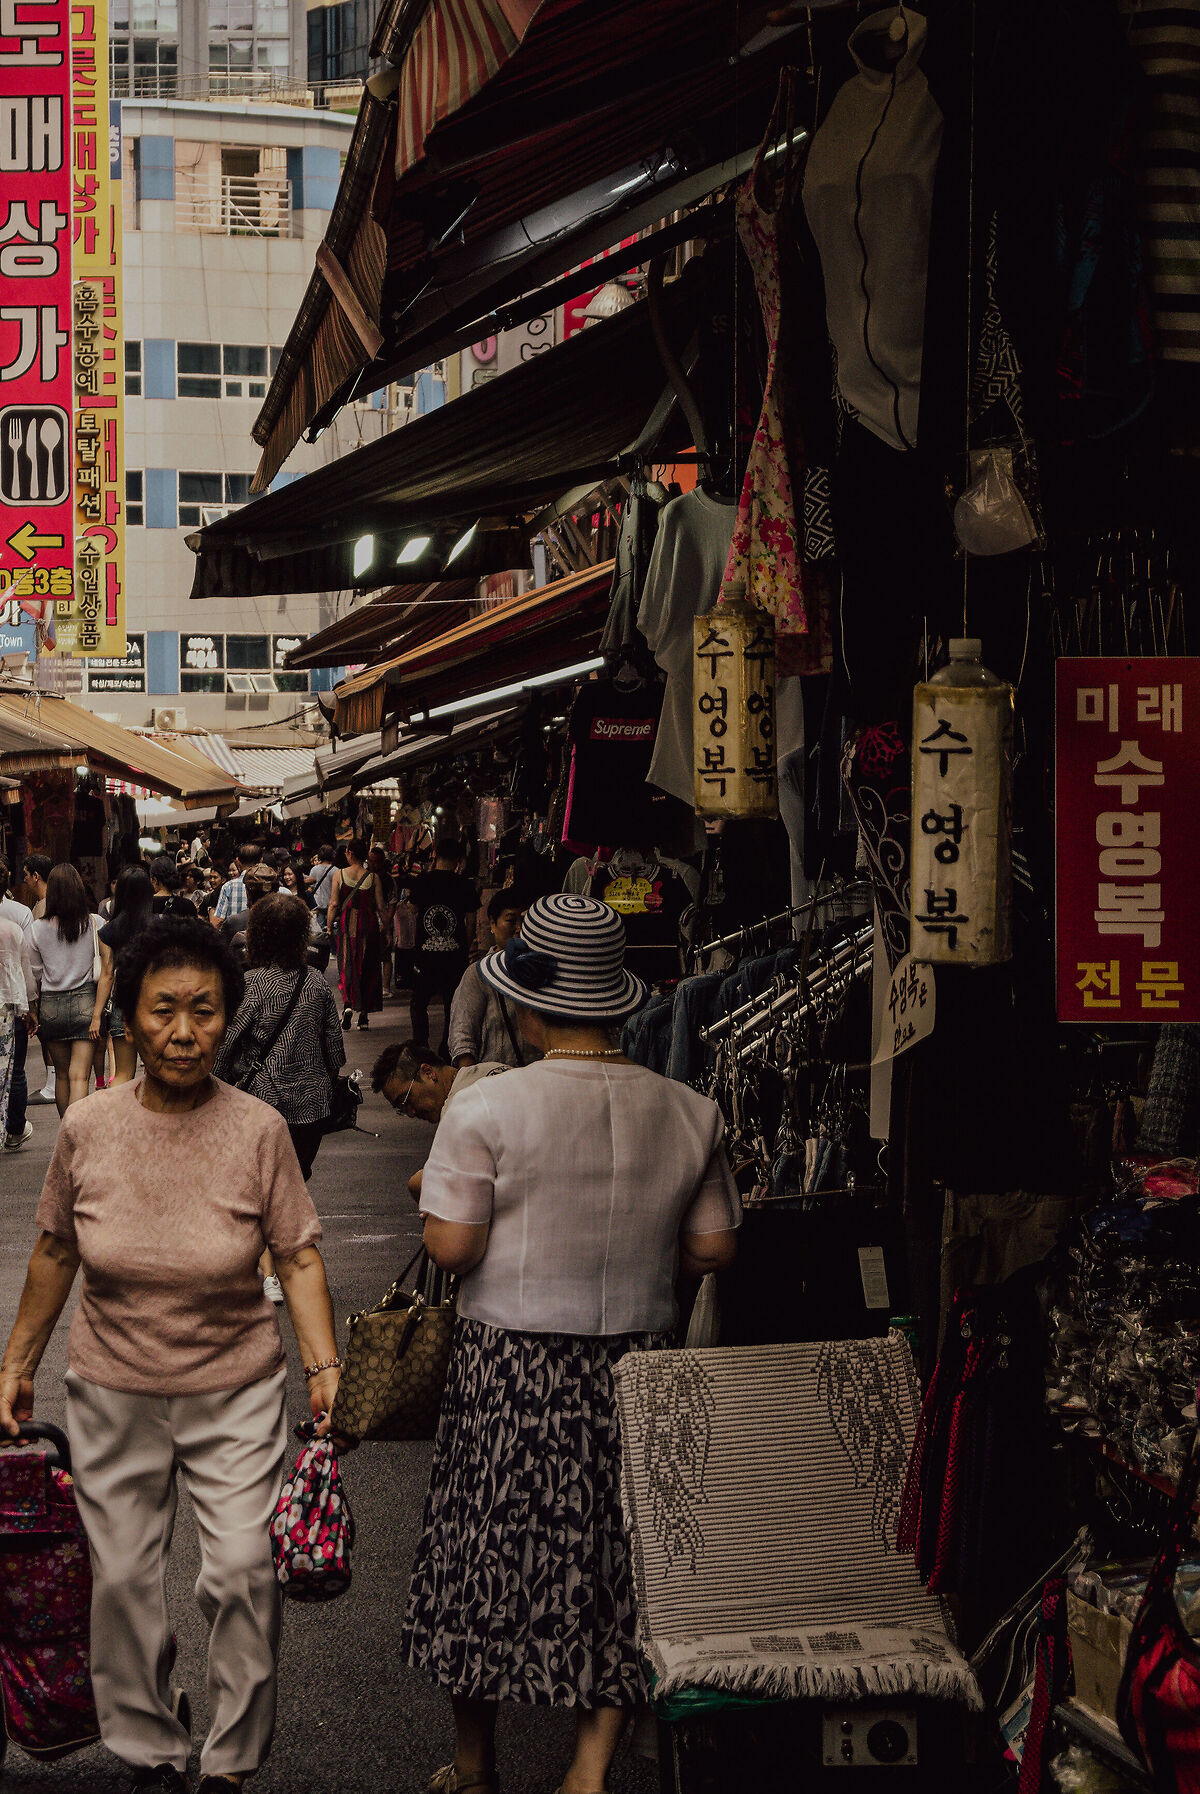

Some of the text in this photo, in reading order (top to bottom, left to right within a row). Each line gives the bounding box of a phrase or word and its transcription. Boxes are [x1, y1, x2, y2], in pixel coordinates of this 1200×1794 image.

[75, 286, 99, 395] 혼수공예
[77, 414, 101, 519] 토탈패션
[79, 541, 102, 648] 수입상품
[594, 719, 651, 738] Supreme
[696, 627, 736, 797] 수영복
[1076, 683, 1183, 733] 미래
[914, 718, 973, 950] 수영복
[1094, 740, 1165, 948] 수영복
[1075, 959, 1185, 1009] 전문
